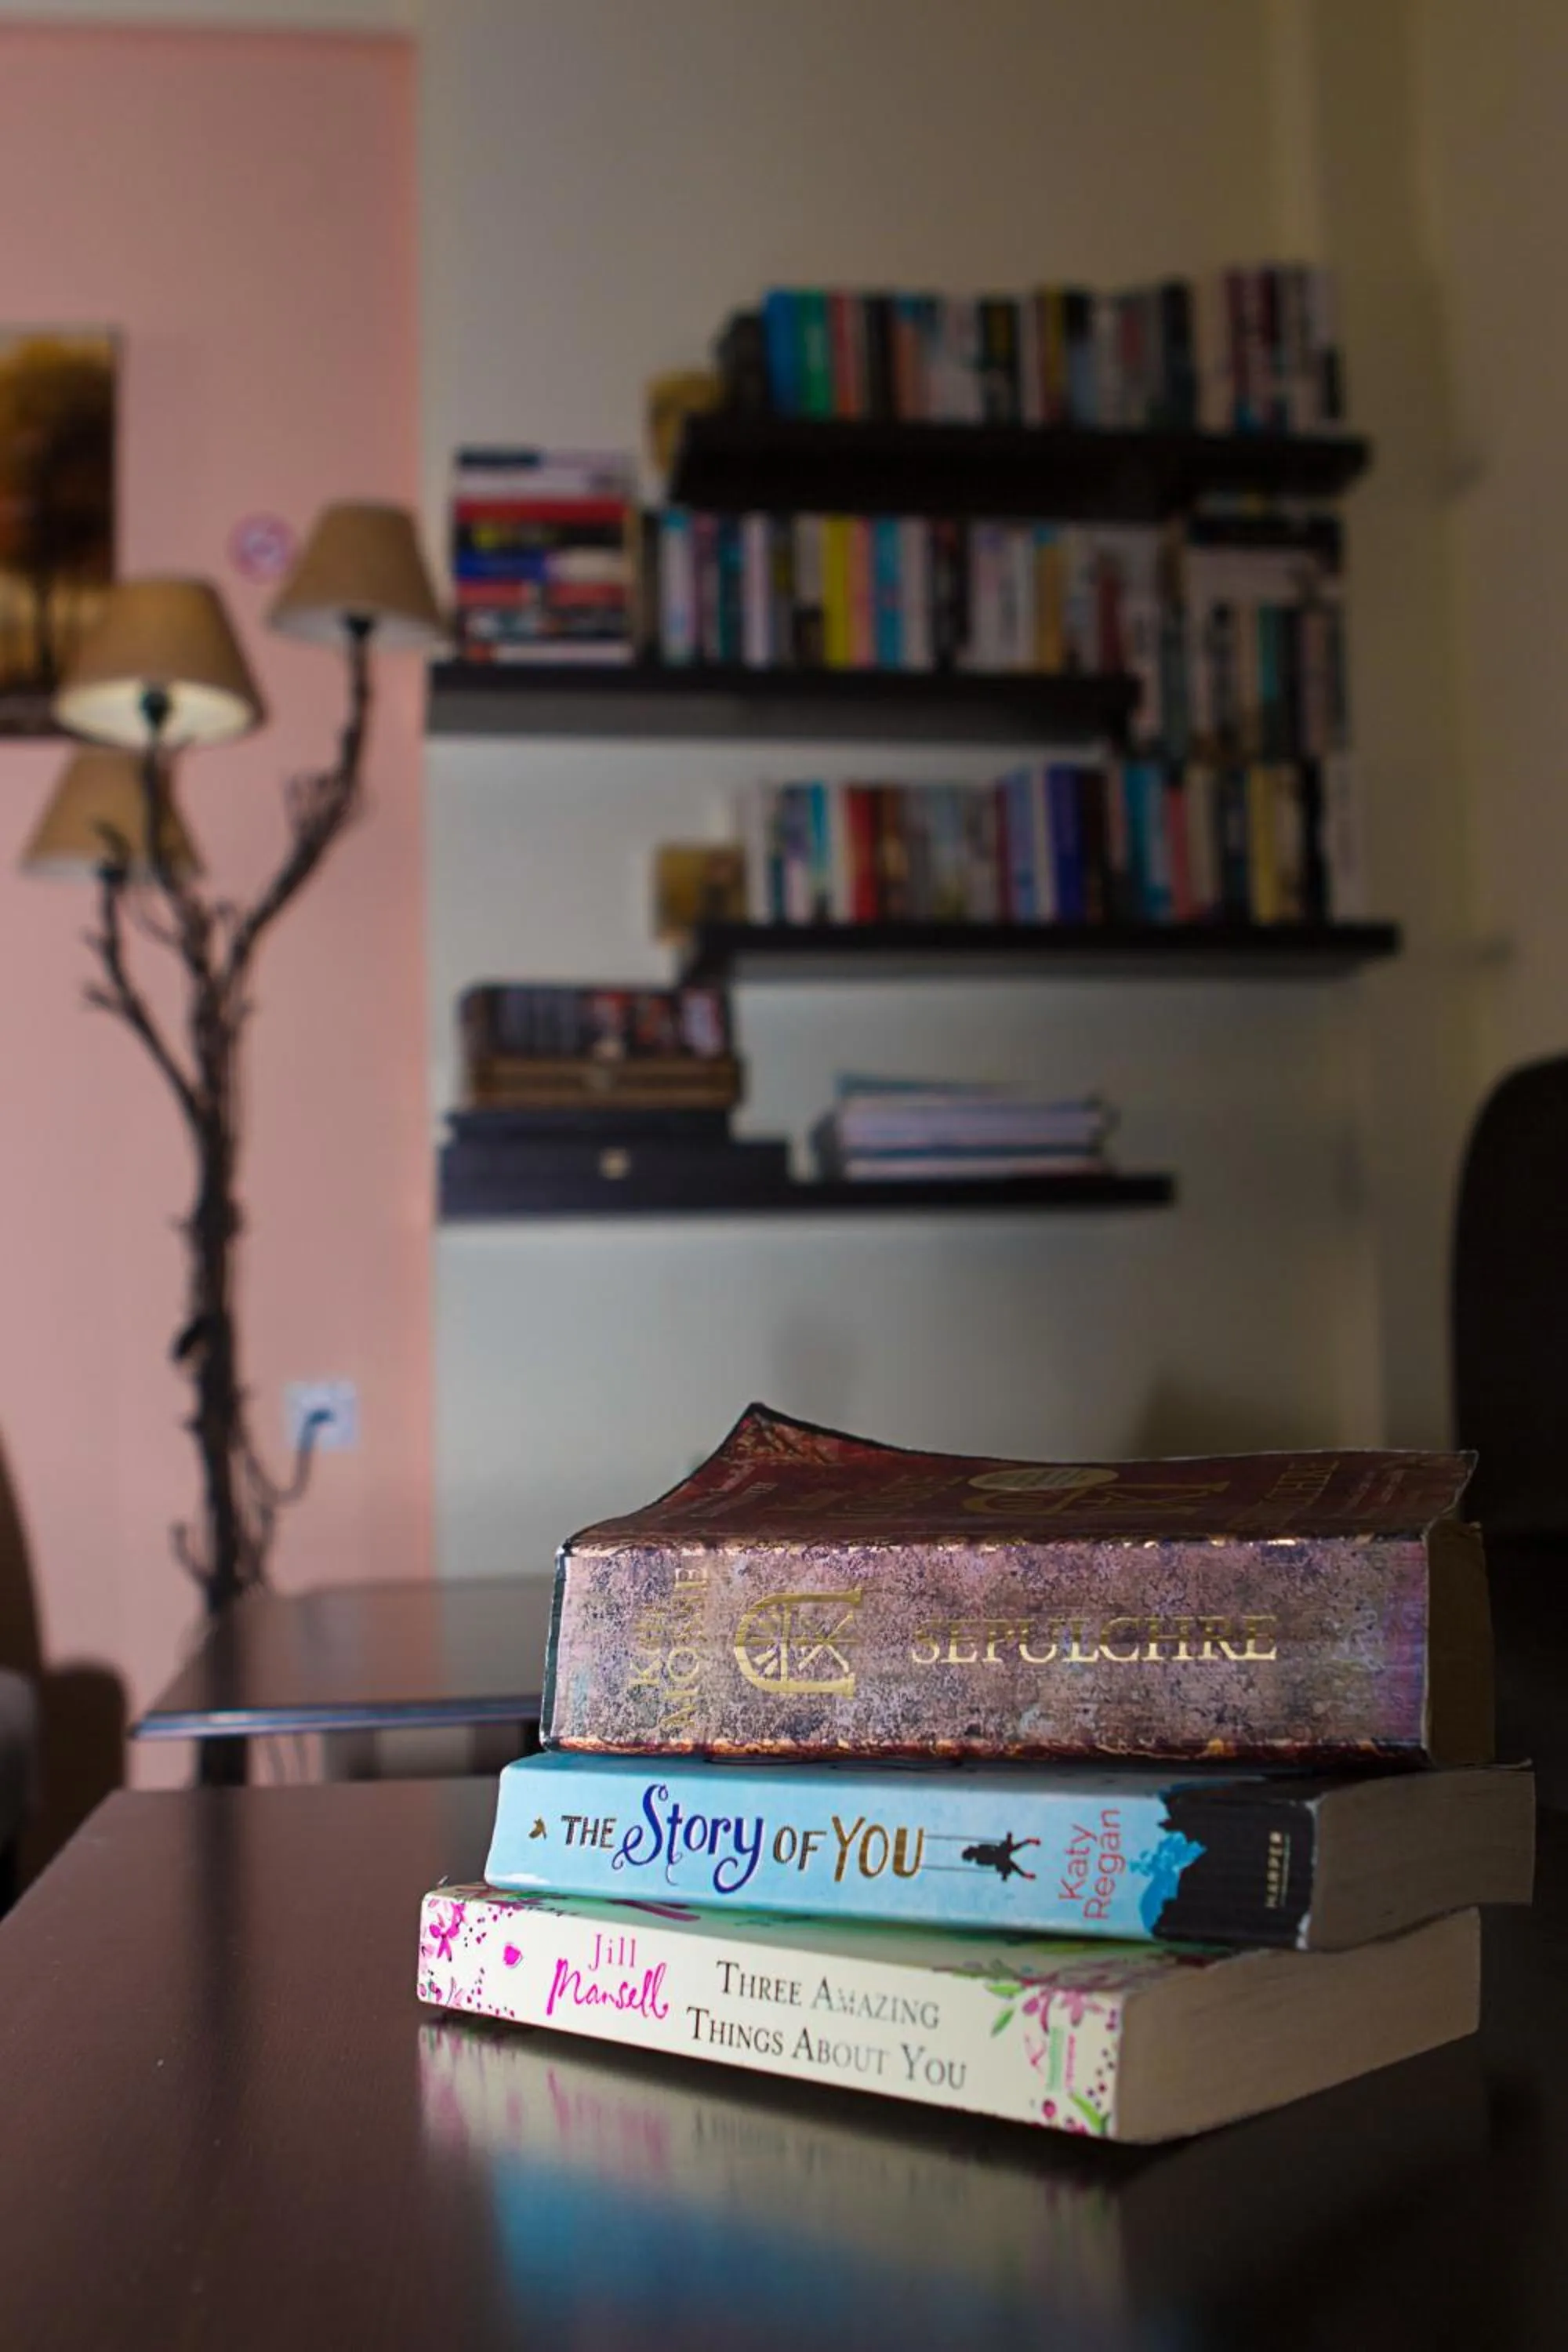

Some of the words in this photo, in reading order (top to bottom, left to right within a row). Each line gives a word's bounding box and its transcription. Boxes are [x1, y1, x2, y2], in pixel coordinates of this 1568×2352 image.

[629, 1604, 662, 1687] KA
[664, 1568, 707, 1729] MOE
[910, 1615, 1277, 1664] SEPULCHRE
[561, 1814, 618, 1849] THE
[612, 1783, 764, 1894] Story
[772, 1825, 828, 1871] OF
[831, 1815, 925, 1882] YOU
[1059, 1824, 1098, 1901] Katy
[1083, 1806, 1127, 1920] Regan
[546, 1957, 670, 2020] Mansell
[588, 1933, 636, 1972] Jill
[716, 1959, 803, 2007] THREE
[809, 1976, 941, 2031] AMAZING
[686, 2005, 785, 2056] THINGS
[791, 2026, 892, 2076] ABOUT
[899, 2042, 968, 2091] YOU
